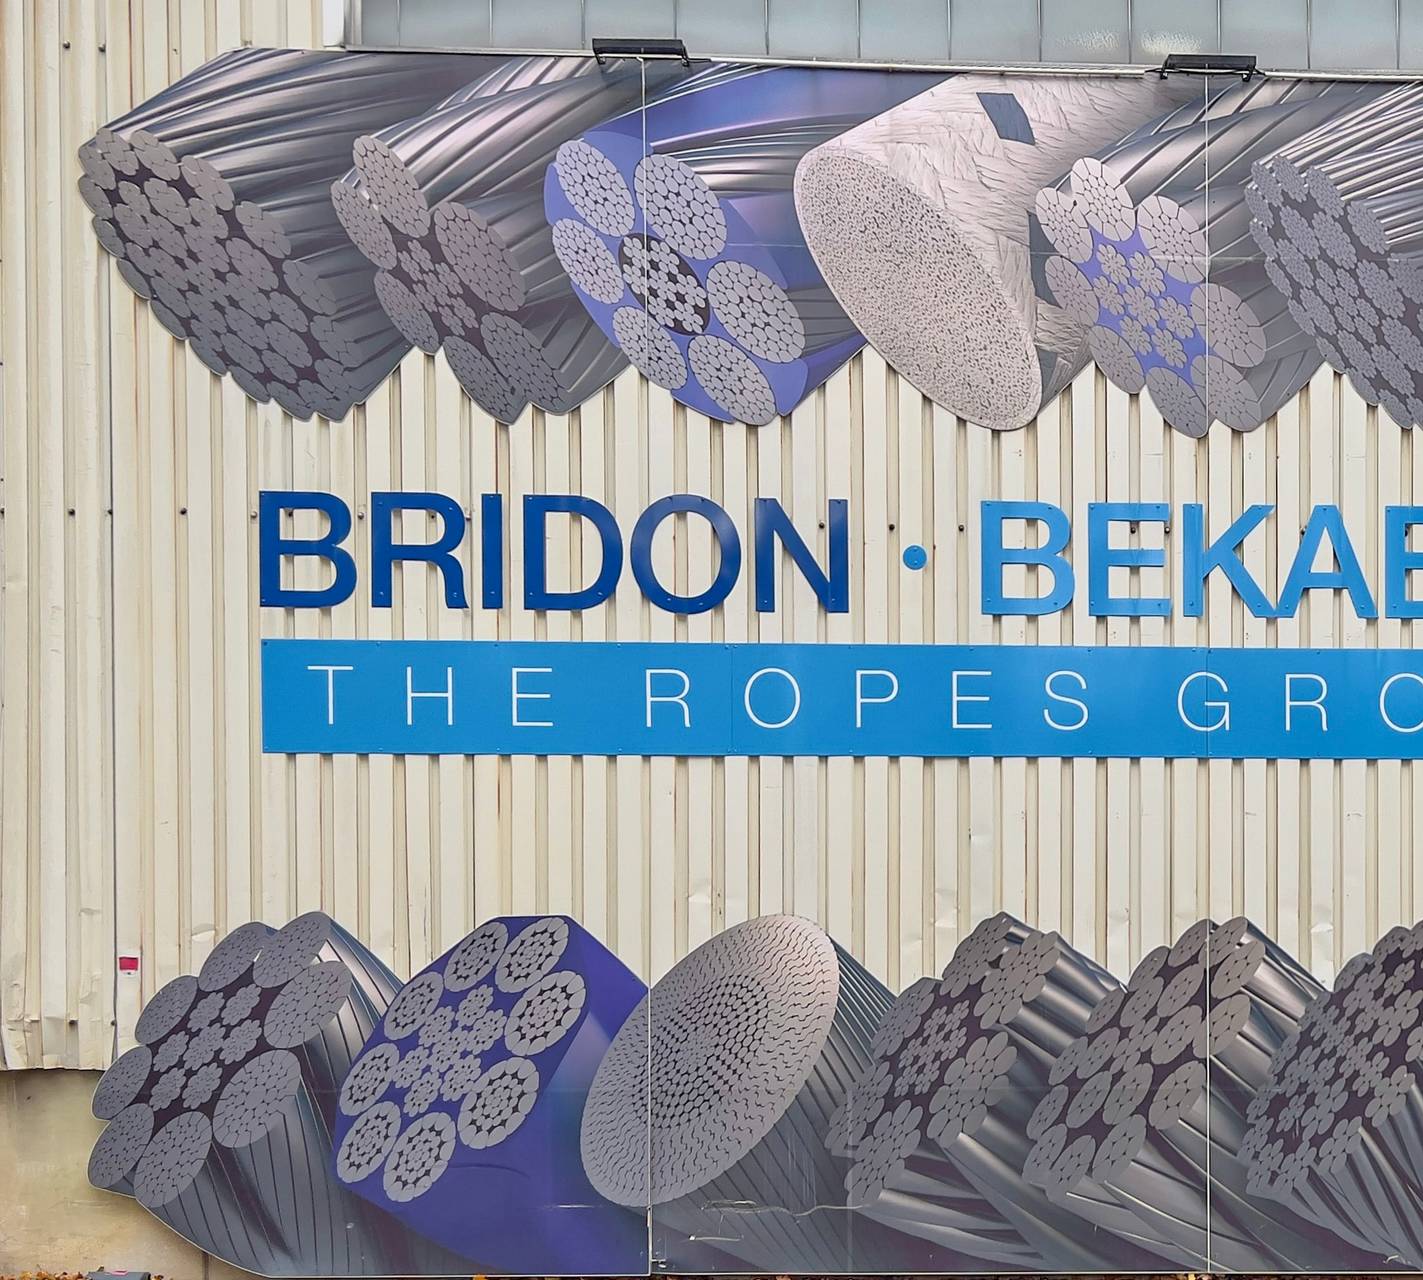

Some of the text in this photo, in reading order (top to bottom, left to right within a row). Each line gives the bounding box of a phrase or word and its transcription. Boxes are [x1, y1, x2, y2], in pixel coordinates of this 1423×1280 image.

[259, 491, 849, 615] BRIDON
[307, 665, 554, 727] THE
[645, 667, 1090, 731] ROPES
